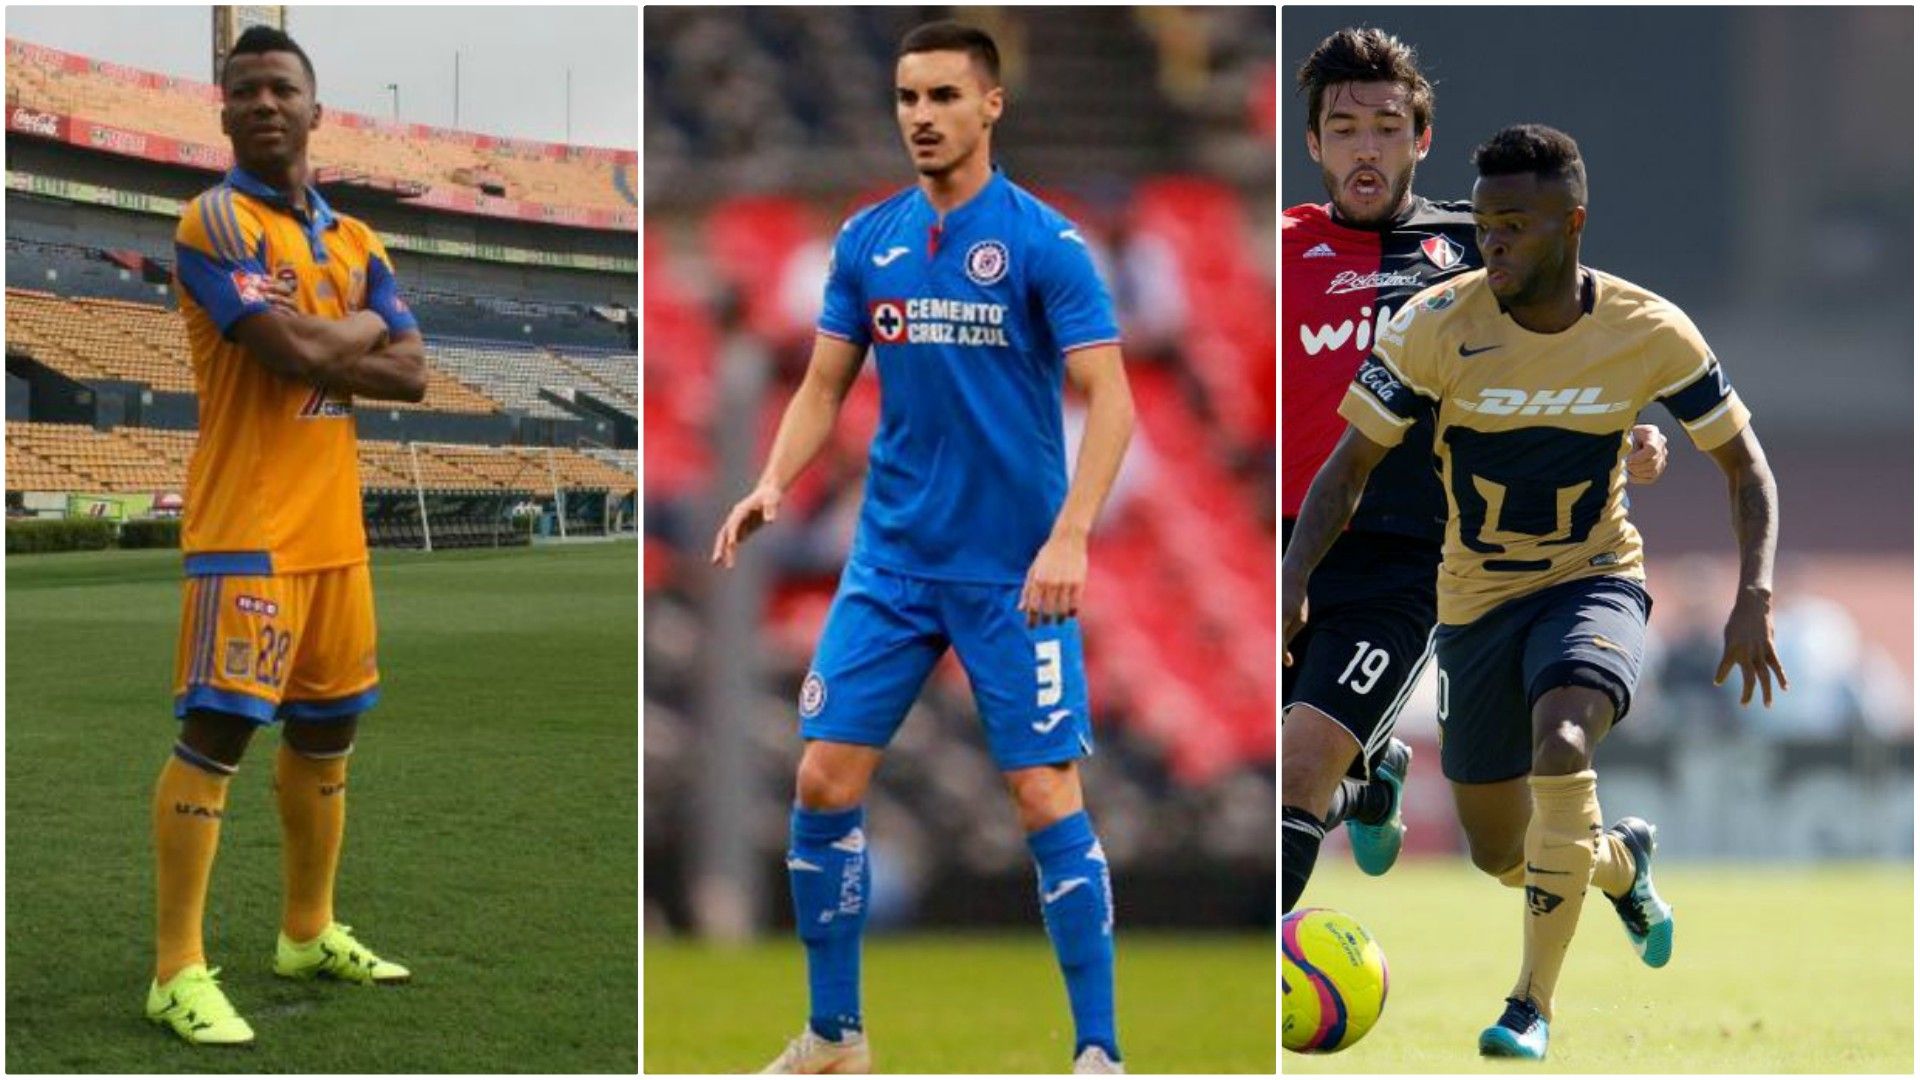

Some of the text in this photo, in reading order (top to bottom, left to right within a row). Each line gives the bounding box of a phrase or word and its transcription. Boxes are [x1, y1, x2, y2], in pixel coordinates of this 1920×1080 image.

[906, 298, 1003, 323] CEMENTO
[907, 323, 1009, 346] CRUZ AZUL
[1476, 386, 1612, 416] DHL
[255, 623, 292, 688] 28
[1034, 639, 1062, 708] 3
[1337, 640, 1391, 695] 19
